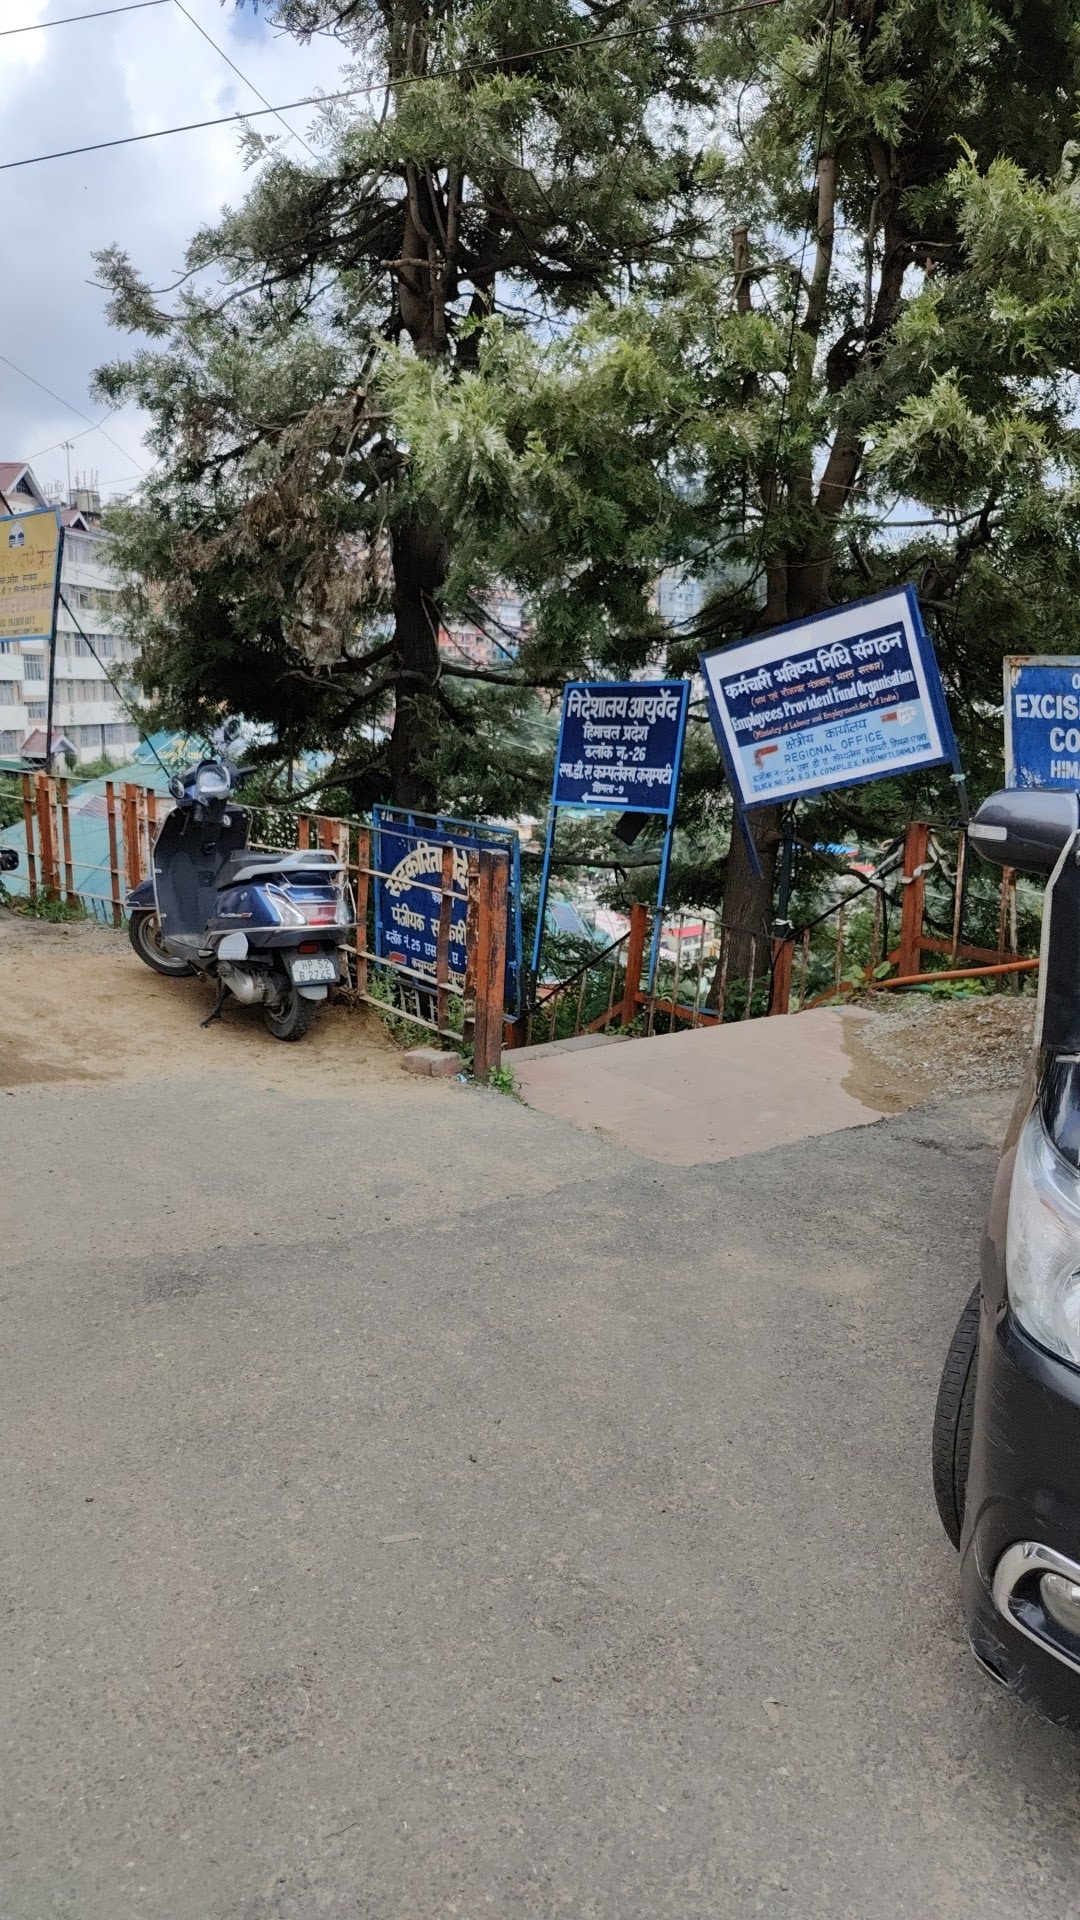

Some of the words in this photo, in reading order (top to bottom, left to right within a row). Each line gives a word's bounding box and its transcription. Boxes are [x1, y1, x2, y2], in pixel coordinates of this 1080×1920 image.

[724, 668, 773, 699] कर्मचारी
[774, 660, 819, 683] भविष्य
[818, 643, 852, 672] निधि
[851, 631, 902, 660] संगठन
[836, 669, 855, 680] भारत
[567, 688, 629, 720] निदेशालय
[628, 687, 680, 724] आयुर्वेद
[731, 704, 784, 732] Employees
[781, 687, 836, 718] Provident
[832, 681, 858, 703] Fund
[856, 669, 915, 699] Organisation
[1015, 694, 1080, 720] EXCIS
[582, 720, 621, 741] हिमाचल
[621, 720, 649, 742] प्रदेश
[789, 718, 811, 730] Labour
[812, 714, 822, 723] and
[785, 732, 815, 751] क्षेत्रीय
[824, 717, 867, 738] कार्यालय
[583, 741, 613, 760] ब्लॉक
[784, 743, 837, 764] REGIONAL
[841, 730, 883, 749] OFFICE
[753, 781, 773, 793] BLOCK
[391, 903, 425, 932] पंजीयक
[386, 929, 402, 945] ब्लॉक
[299, 971, 306, 981] B
[308, 969, 332, 981] 2745
[301, 960, 313, 970] HP
[317, 959, 330, 970] 52
